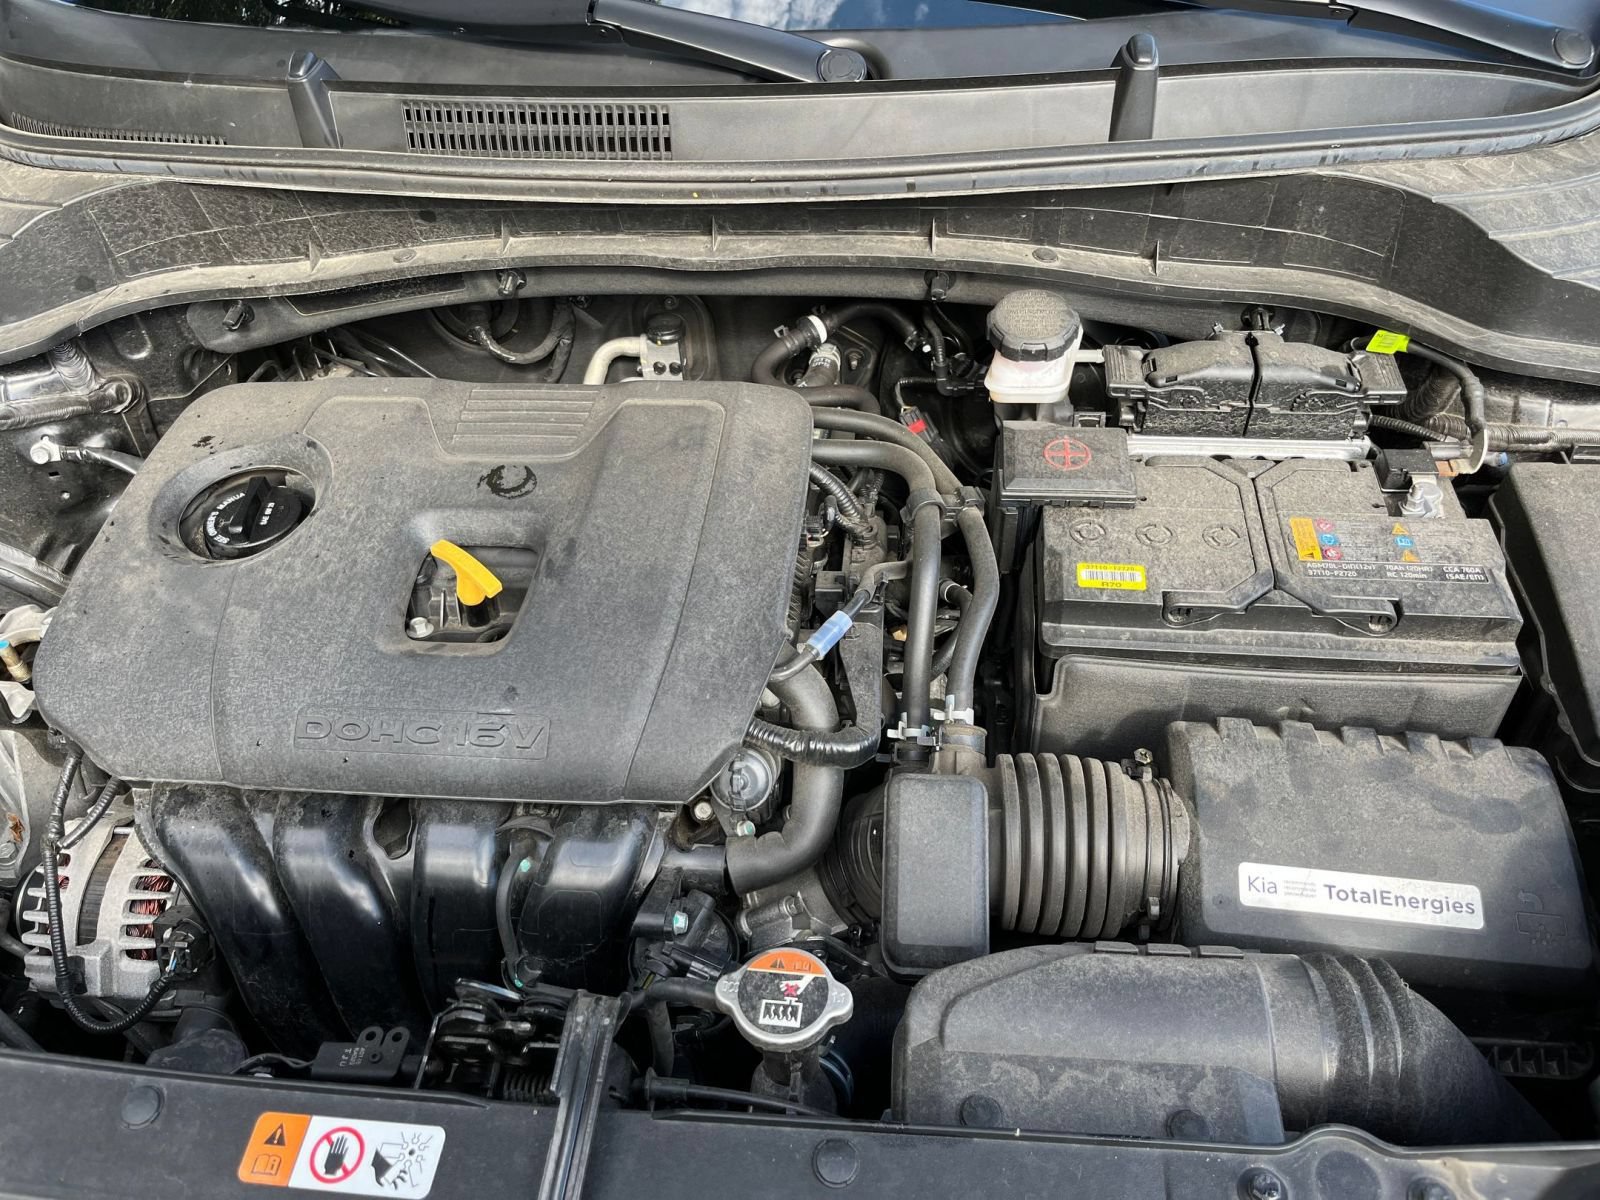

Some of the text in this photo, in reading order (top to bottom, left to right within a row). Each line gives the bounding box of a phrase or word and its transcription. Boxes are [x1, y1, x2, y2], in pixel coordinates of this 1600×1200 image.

[216, 492, 246, 510] MANUA
[296, 714, 545, 750] DOHC 16V
[1247, 874, 1477, 916] Kia TotalEnergies
